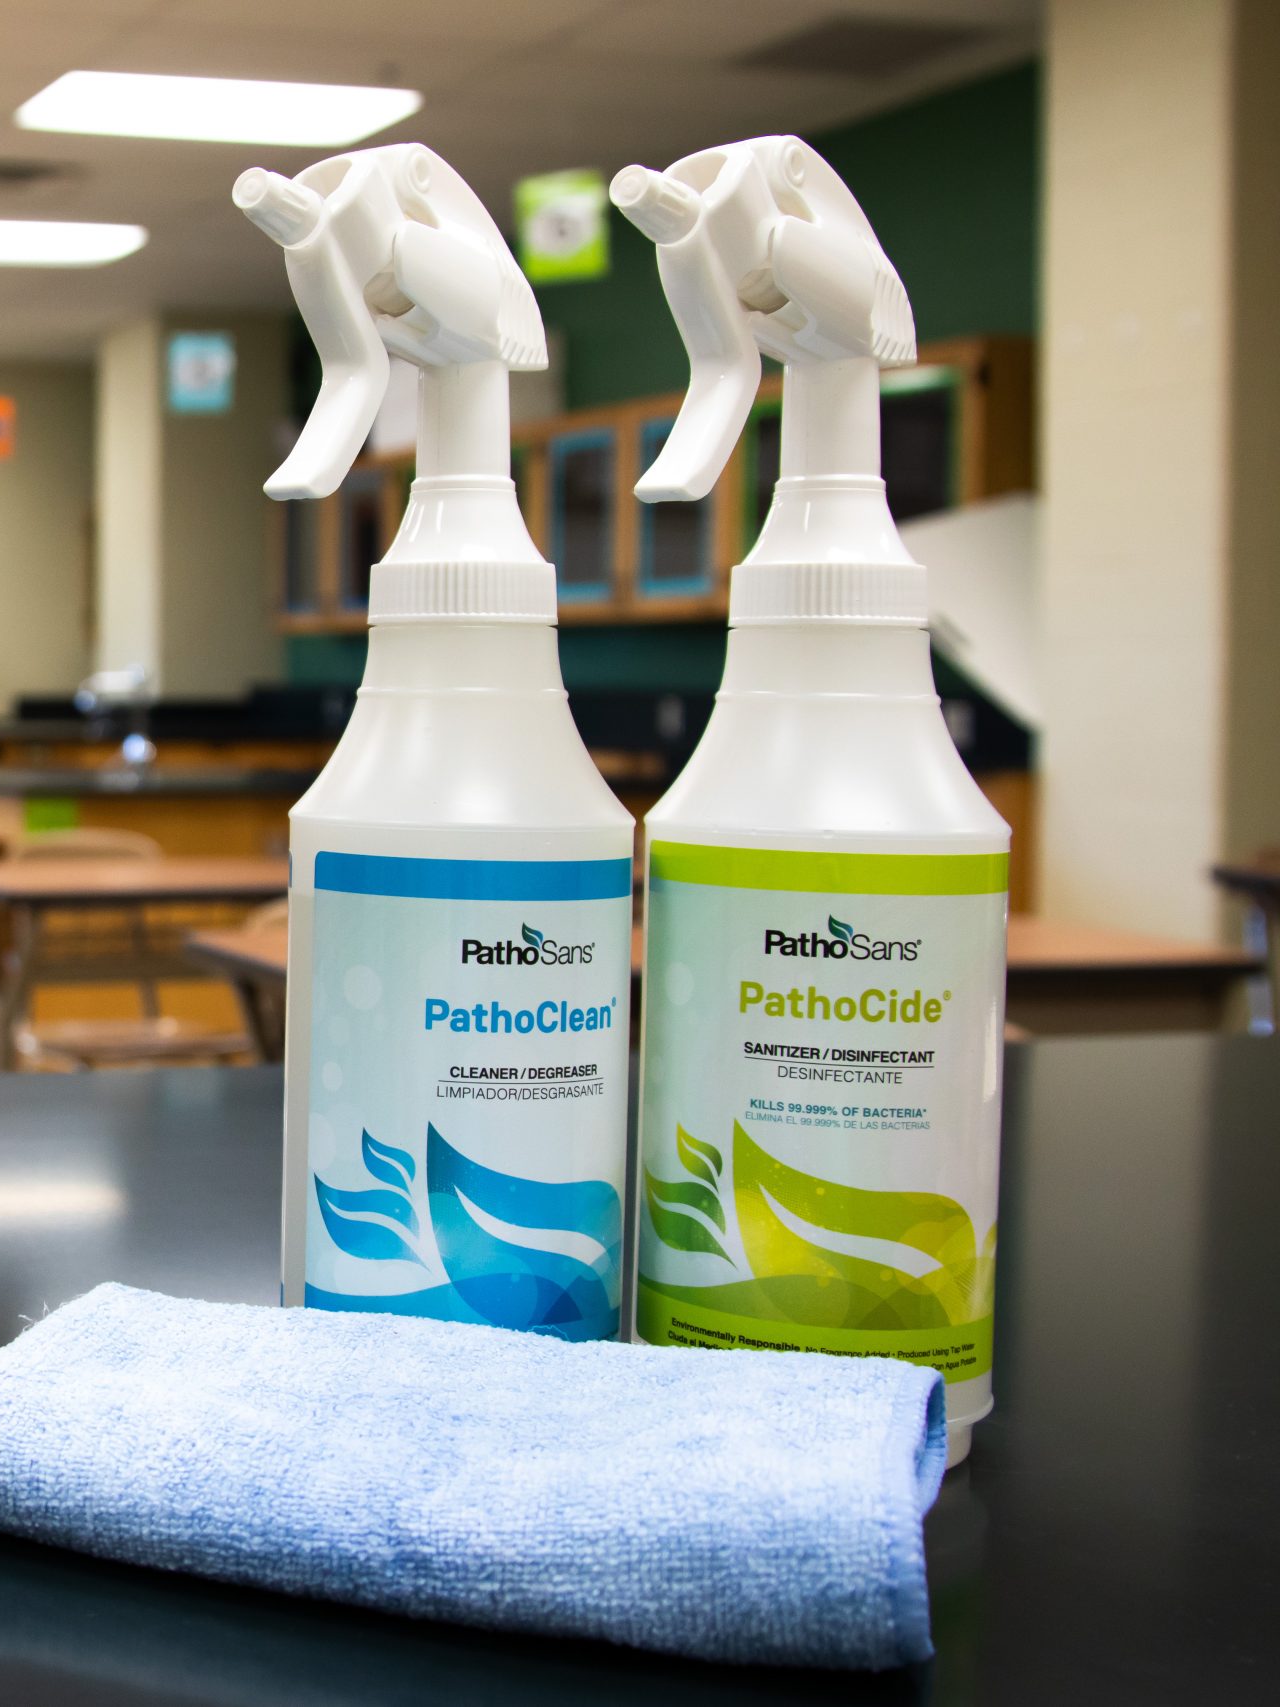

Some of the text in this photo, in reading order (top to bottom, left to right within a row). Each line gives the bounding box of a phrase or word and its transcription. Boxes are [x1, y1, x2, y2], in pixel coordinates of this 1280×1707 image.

[744, 1042, 820, 1060] SANITIZER
[831, 1048, 935, 1063] DISINFECTANT
[450, 1066, 518, 1079] CLEANER
[528, 1064, 597, 1080] DEGREASER
[777, 1065, 903, 1084] DESINFECTANTE
[750, 1098, 785, 1112] KILLS
[788, 1103, 838, 1116] 99.999%
[842, 1106, 859, 1117] OF
[745, 1111, 783, 1123] ELIMINA
[786, 1115, 798, 1125] EL
[843, 1120, 857, 1129] DE
[860, 1121, 878, 1130] LAS
[881, 1121, 930, 1130] BACTERIAS
[671, 1317, 736, 1343] Environmentally
[738, 1335, 801, 1353] Responsible
[897, 1350, 931, 1359] Produced
[932, 1348, 950, 1357] Using
[951, 1346, 961, 1354] Tap
